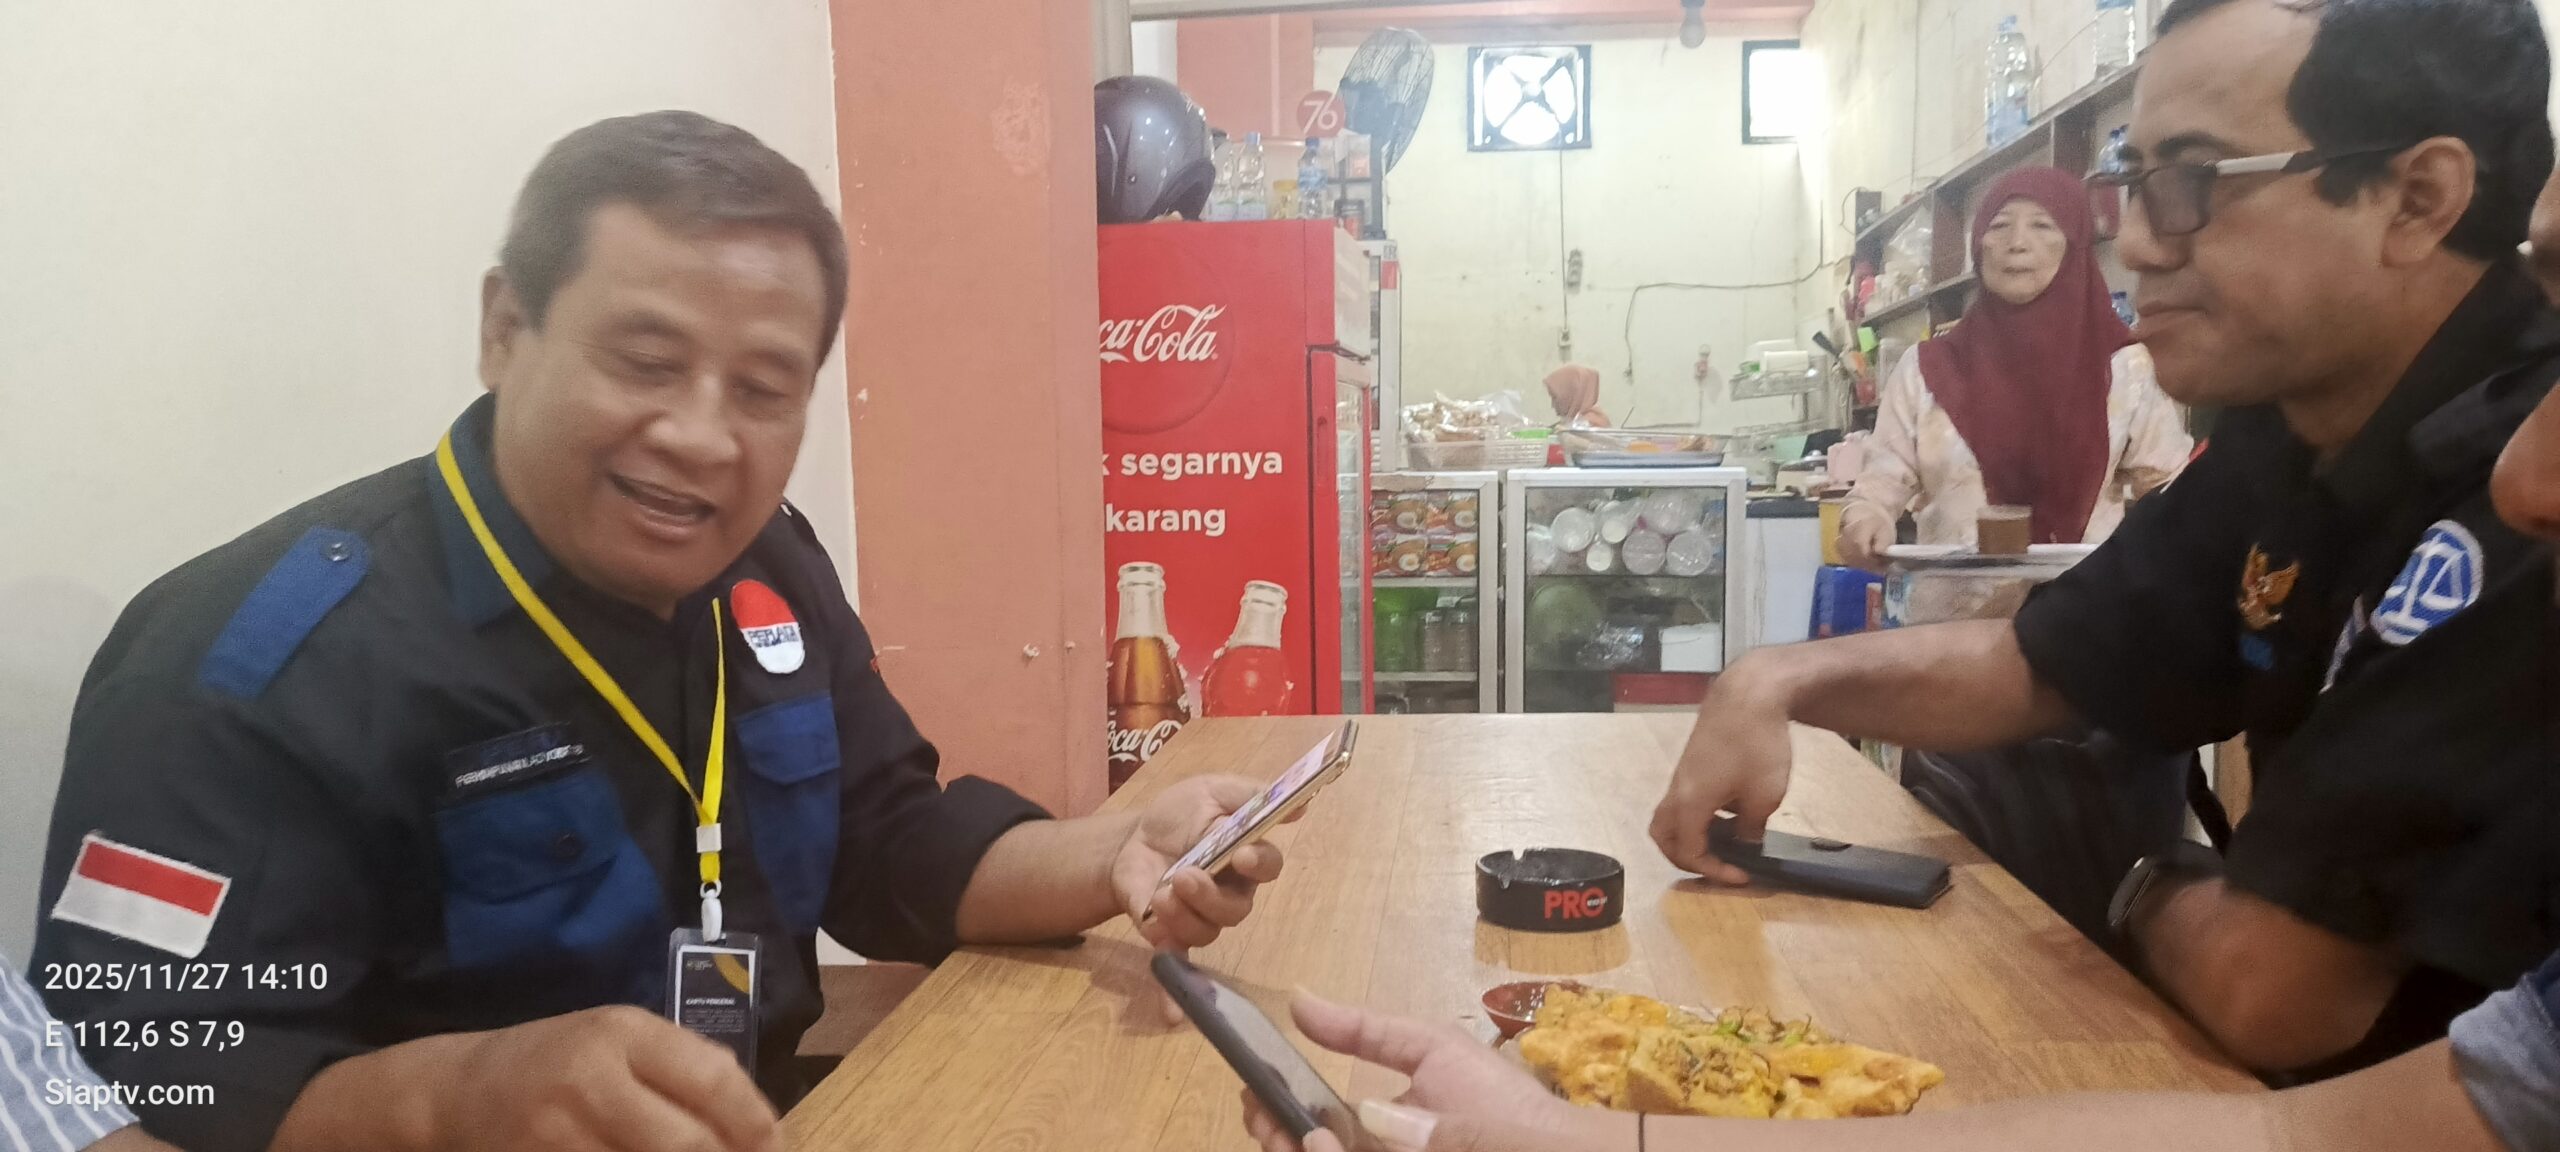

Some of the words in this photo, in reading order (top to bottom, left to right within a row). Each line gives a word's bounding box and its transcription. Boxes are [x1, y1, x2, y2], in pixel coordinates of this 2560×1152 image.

[1303, 93, 1338, 135] 76
[1099, 303, 1227, 363] ca-Cola
[1121, 451, 1283, 480] segarnya
[1105, 503, 1226, 537] karang
[1543, 887, 1605, 920] PRO
